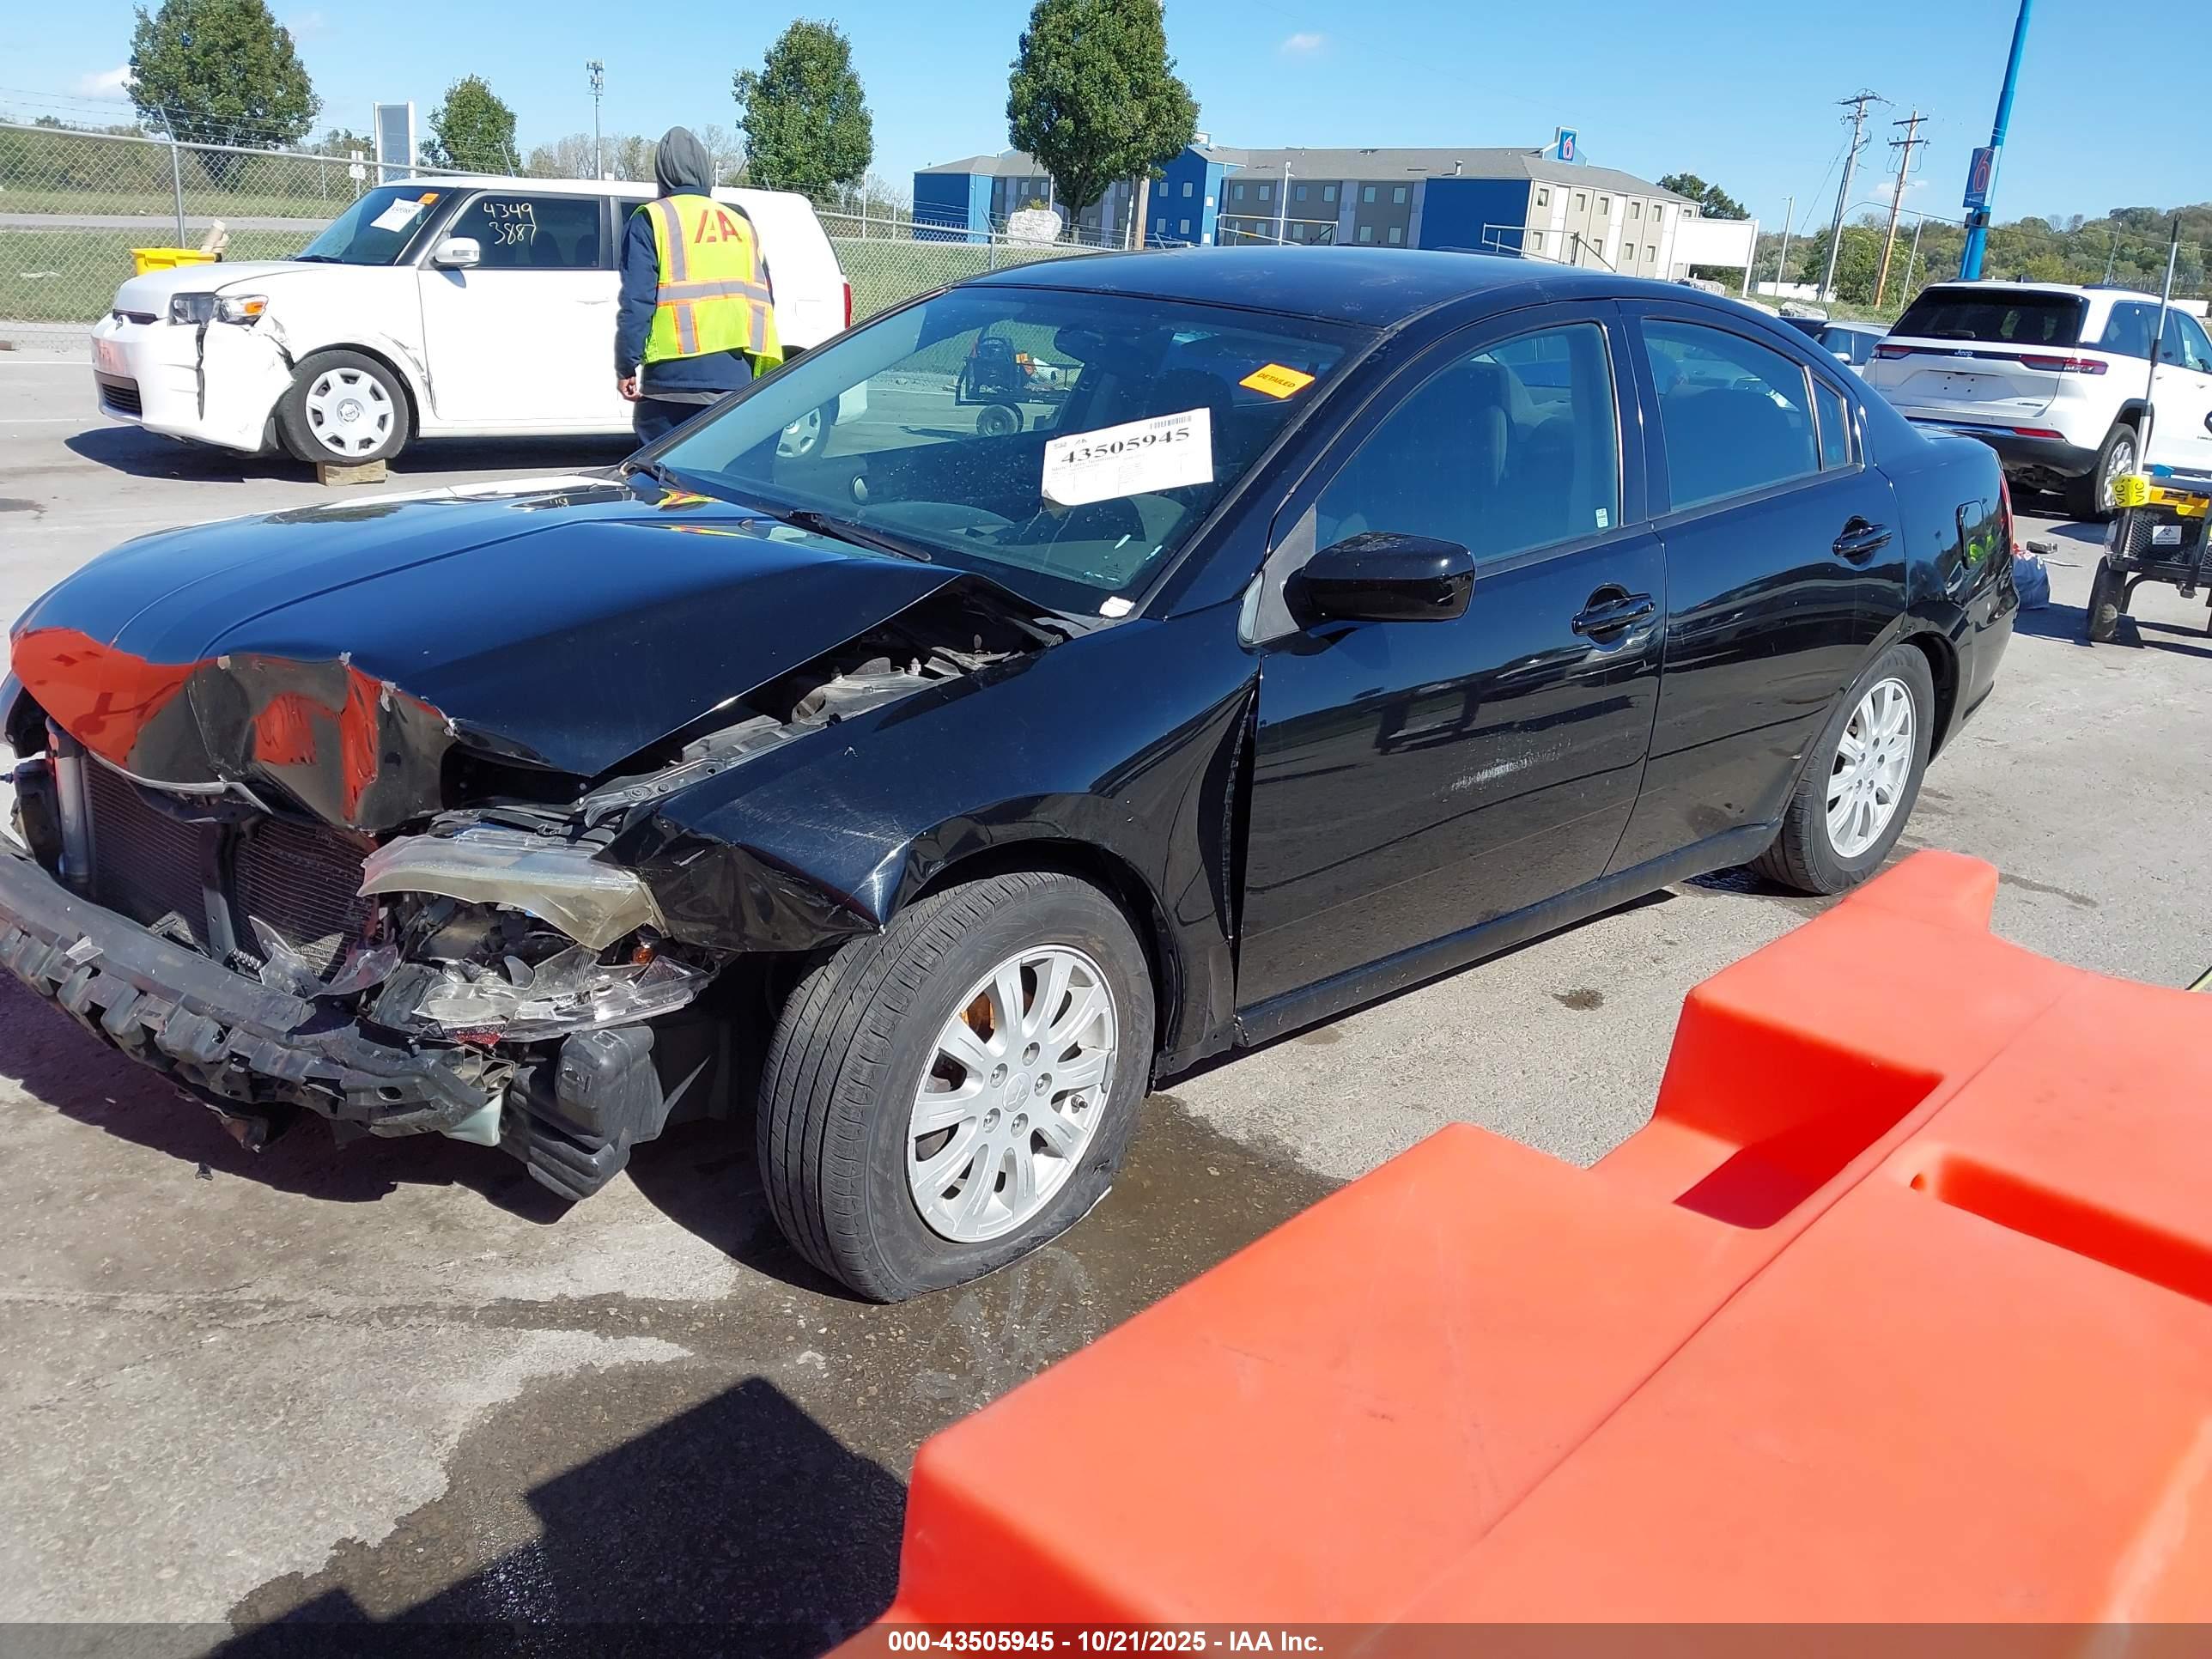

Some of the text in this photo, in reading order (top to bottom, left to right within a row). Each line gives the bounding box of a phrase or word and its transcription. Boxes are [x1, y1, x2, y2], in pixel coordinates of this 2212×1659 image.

[1563, 135, 1574, 160] 6
[1973, 149, 1990, 193] 6
[483, 203, 534, 225] 4349
[489, 222, 537, 246] 3887
[1954, 349, 1973, 358] Jeep
[1256, 373, 1296, 388] DETAILED
[1061, 428, 1190, 464] 43505945
